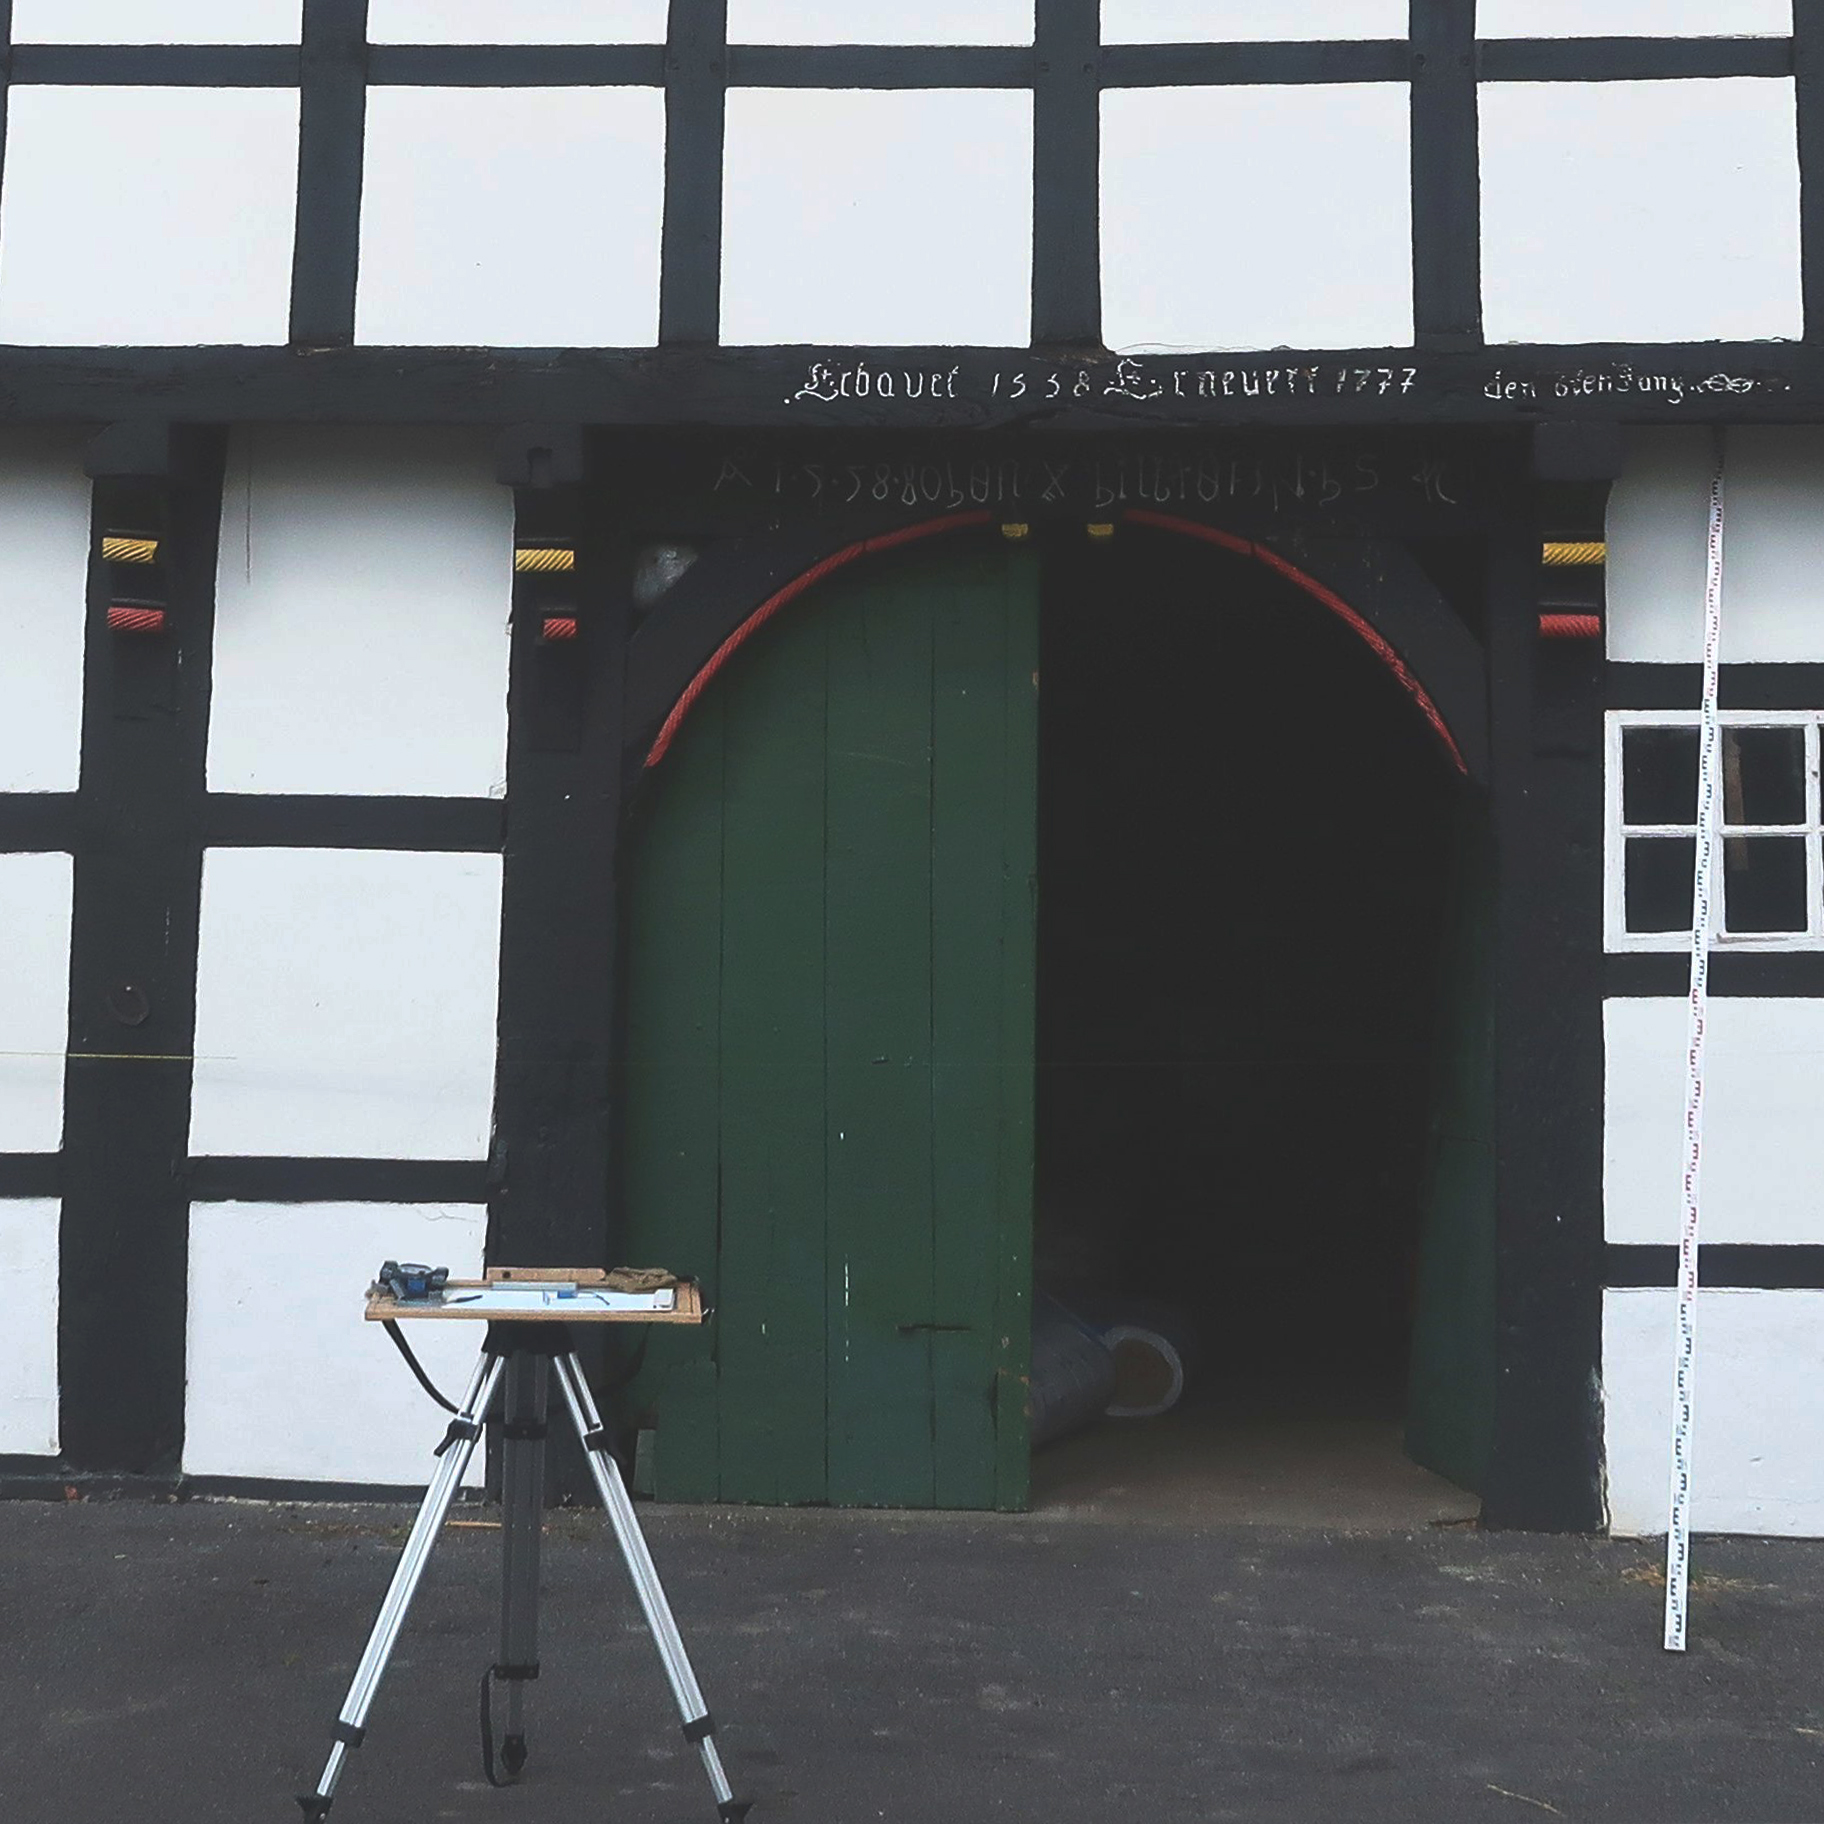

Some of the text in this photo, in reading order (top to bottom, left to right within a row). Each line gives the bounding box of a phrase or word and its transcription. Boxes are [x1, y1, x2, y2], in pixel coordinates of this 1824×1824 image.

[990, 369, 1091, 399] 1558
[1336, 367, 1417, 396] 1777
[1483, 369, 1537, 400] den
